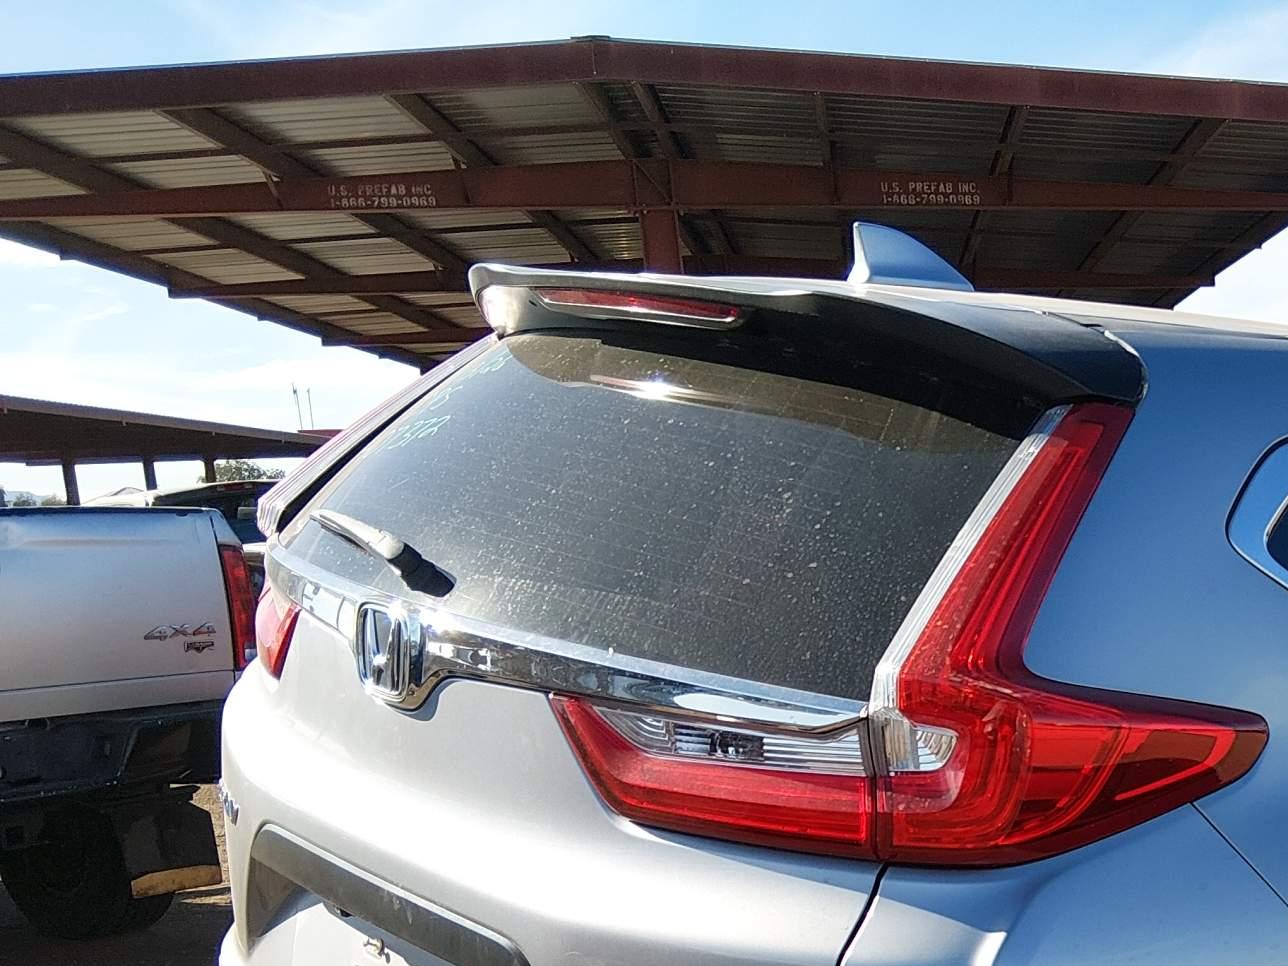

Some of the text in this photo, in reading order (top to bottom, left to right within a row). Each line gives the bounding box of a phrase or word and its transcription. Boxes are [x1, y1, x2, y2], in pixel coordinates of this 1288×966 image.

[358, 183, 406, 196] PREFAB
[880, 182, 904, 193] U.S.
[908, 182, 953, 193] PREFAB
